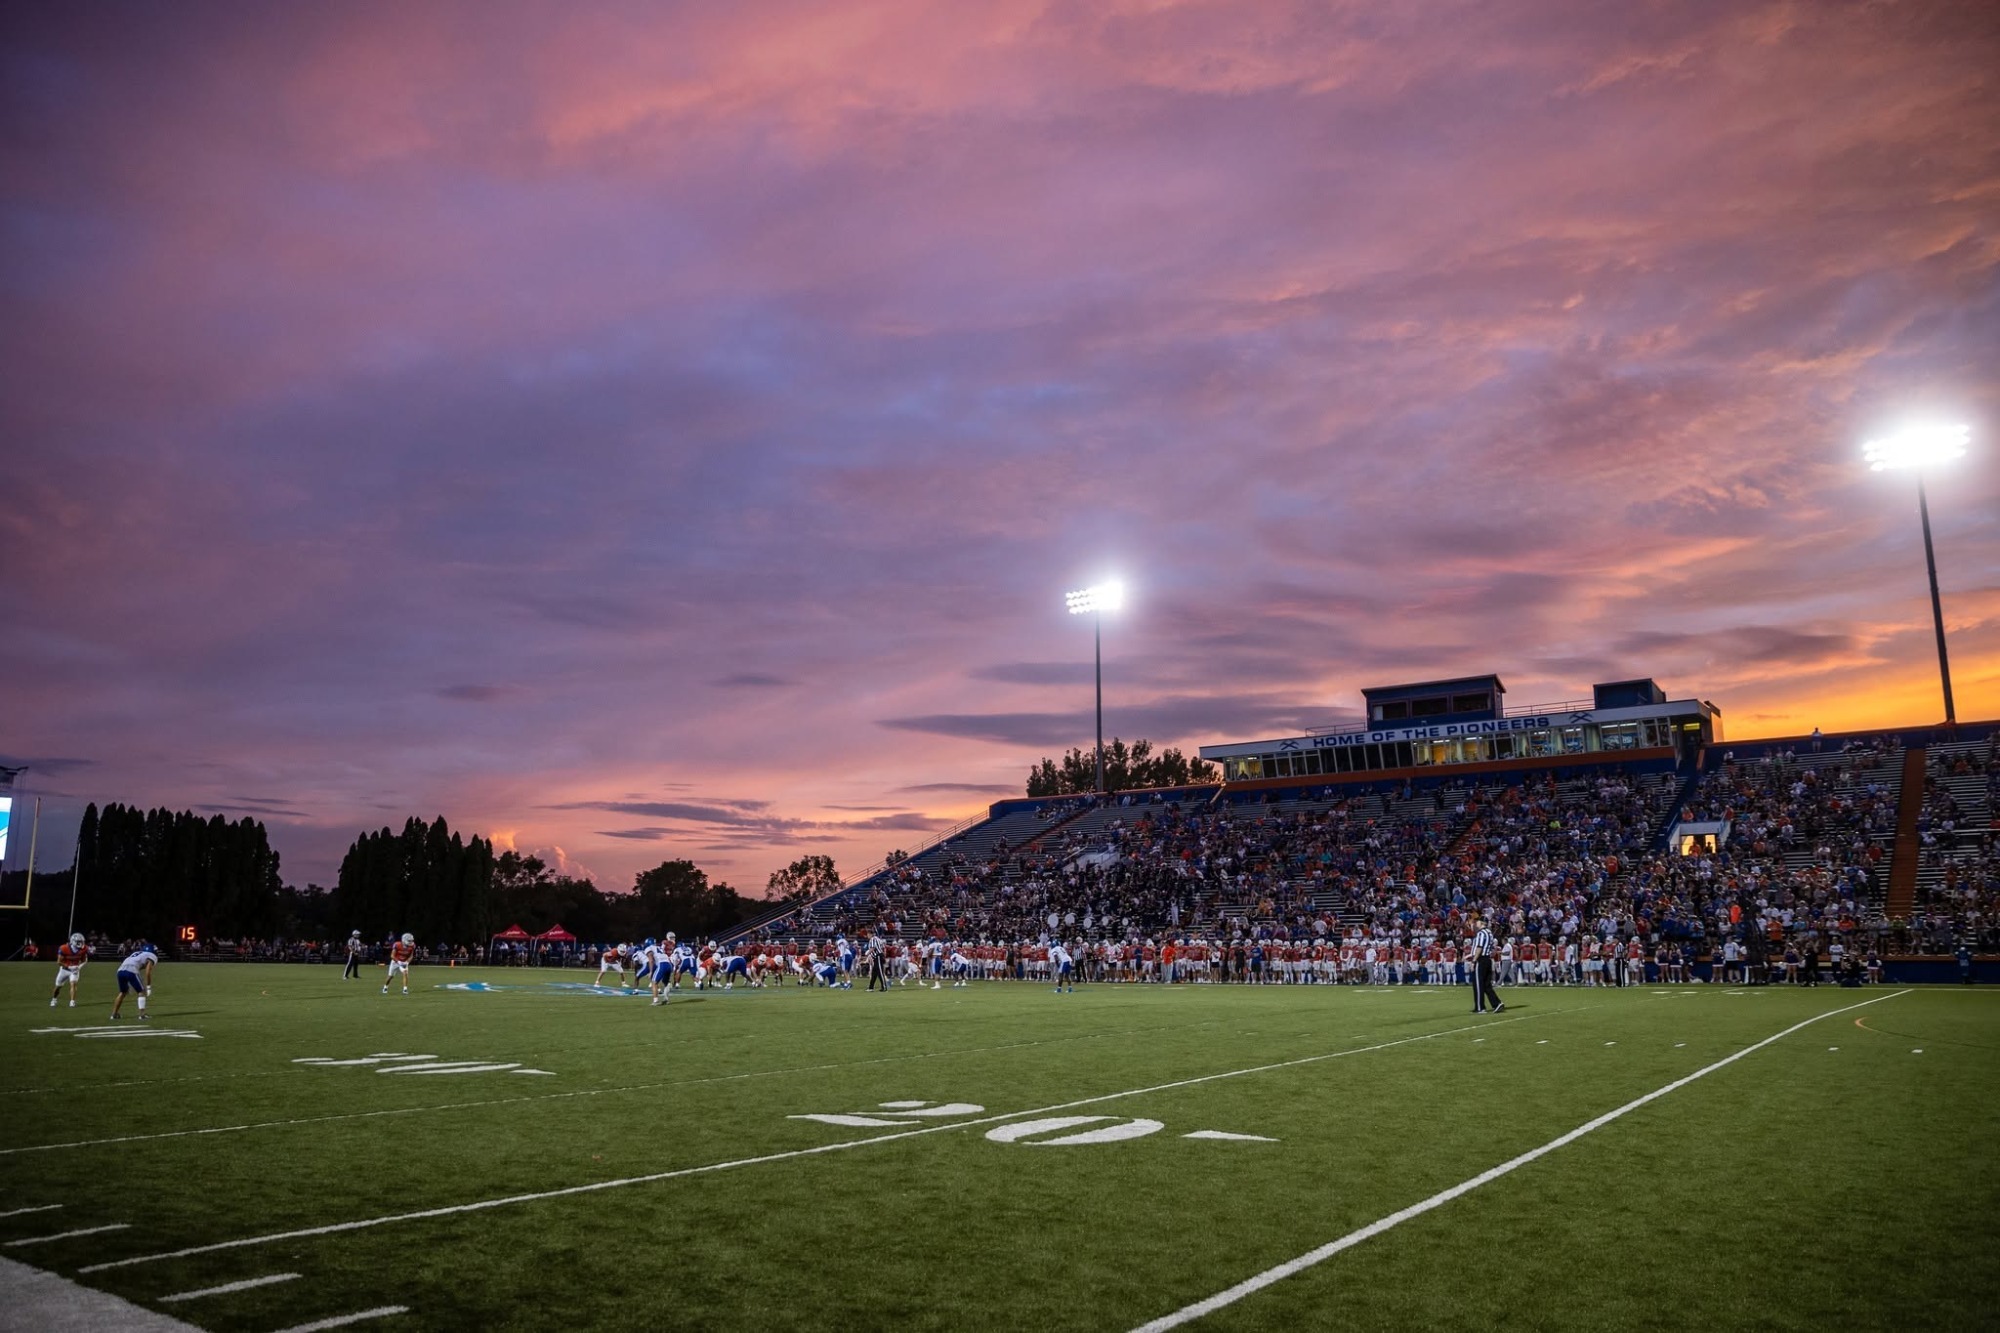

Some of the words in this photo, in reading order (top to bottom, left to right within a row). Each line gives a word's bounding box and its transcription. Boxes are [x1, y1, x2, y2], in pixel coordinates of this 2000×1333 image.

[1313, 734, 1365, 747] HOME
[1371, 731, 1395, 742] OF
[1402, 727, 1439, 738] THE
[1446, 717, 1549, 735] PIONEERS
[182, 927, 195, 939] 15
